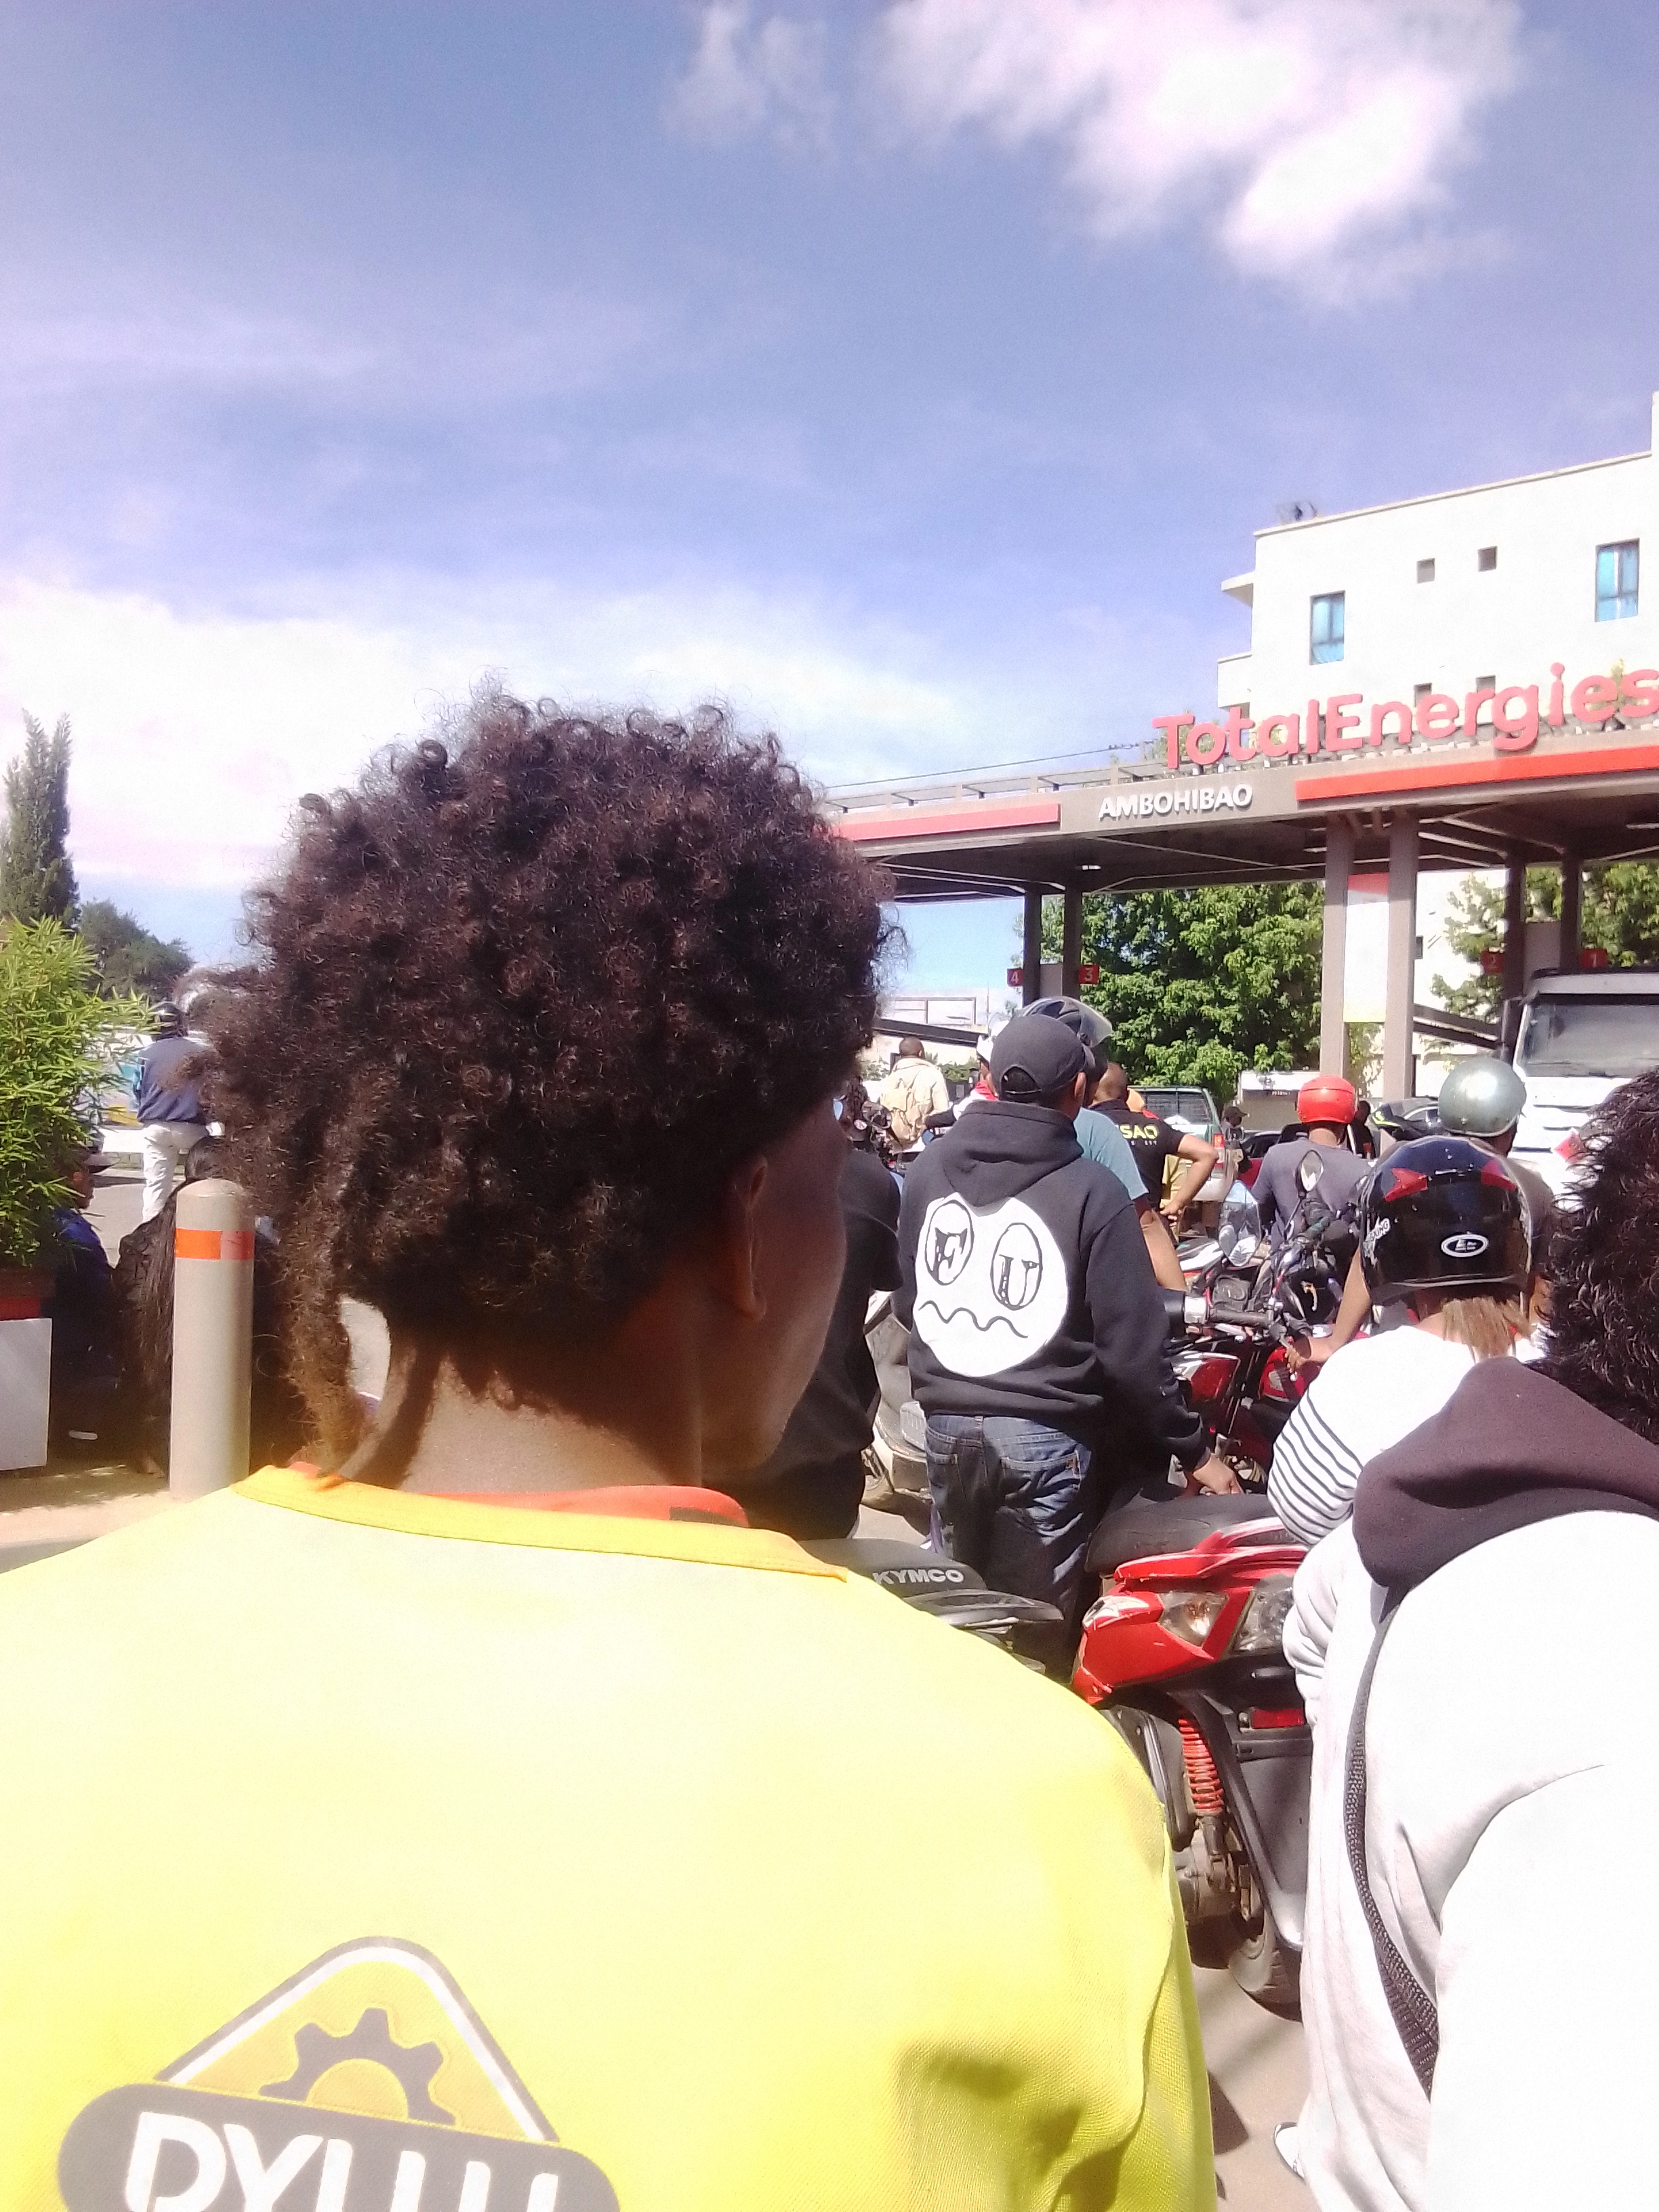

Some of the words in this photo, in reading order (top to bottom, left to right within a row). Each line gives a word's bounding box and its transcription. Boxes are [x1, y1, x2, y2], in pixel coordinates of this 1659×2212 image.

[1151, 661, 1659, 770] TotalEnergies
[1098, 783, 1253, 819] AMBOHIBAO
[1010, 971, 1019, 983] 4
[1084, 966, 1094, 981] 3
[872, 1568, 964, 1585] KYMCO
